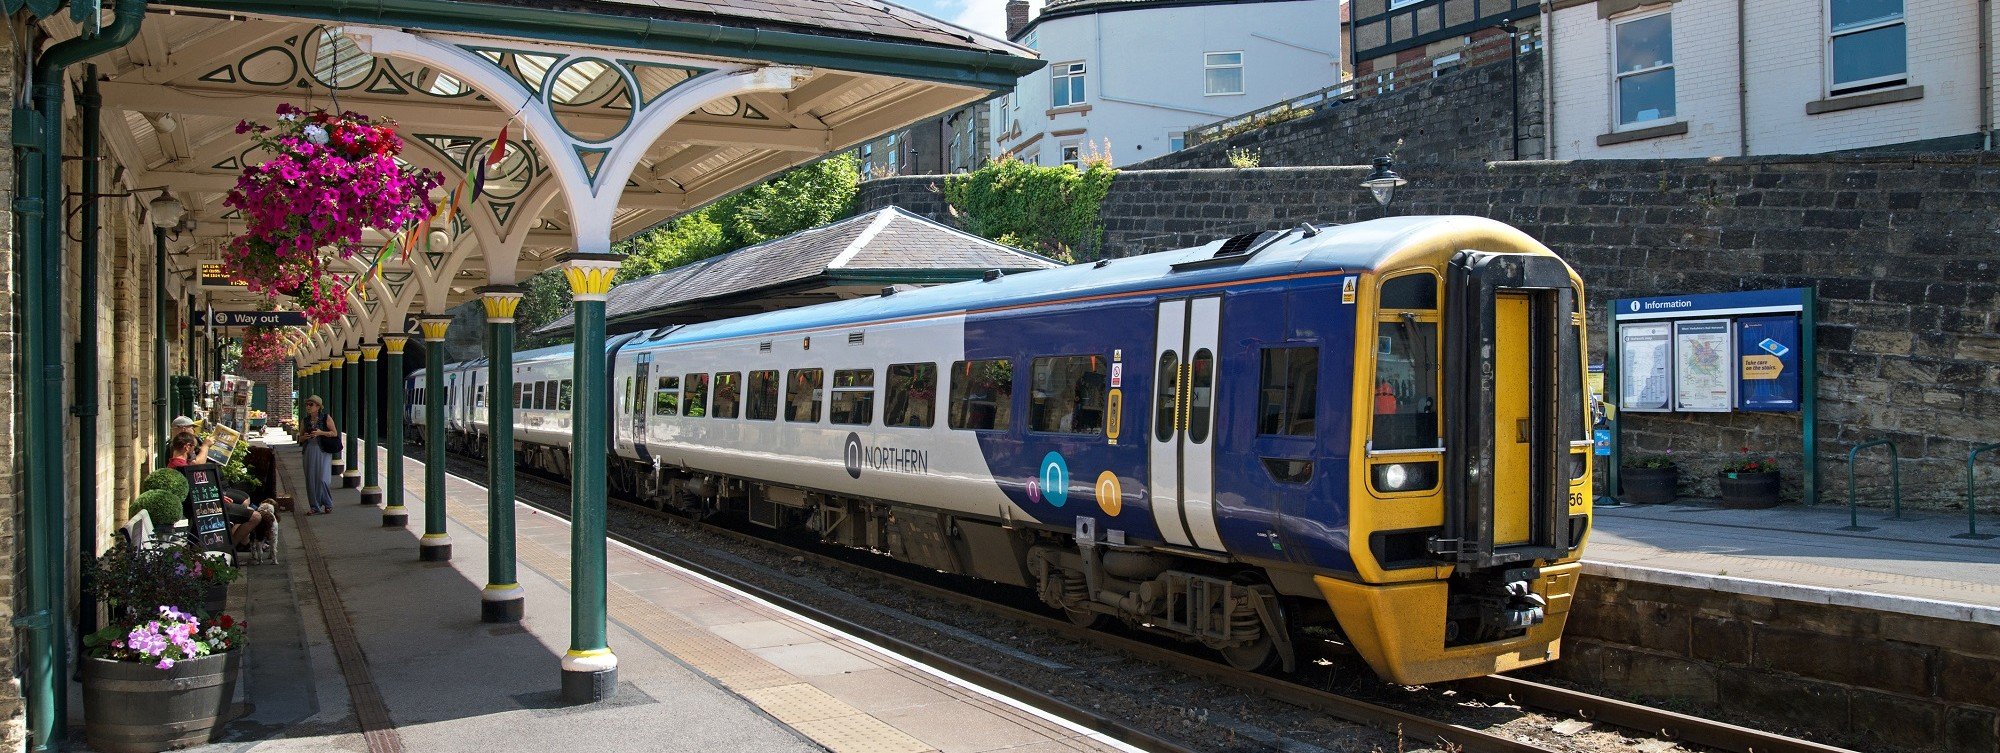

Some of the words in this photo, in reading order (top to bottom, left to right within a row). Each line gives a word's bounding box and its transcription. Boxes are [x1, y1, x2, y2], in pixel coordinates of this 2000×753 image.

[1645, 299, 1692, 309] Information
[234, 314, 257, 324] Way
[260, 314, 280, 323] out
[408, 317, 420, 334] 2
[865, 446, 928, 475] NORTHERN
